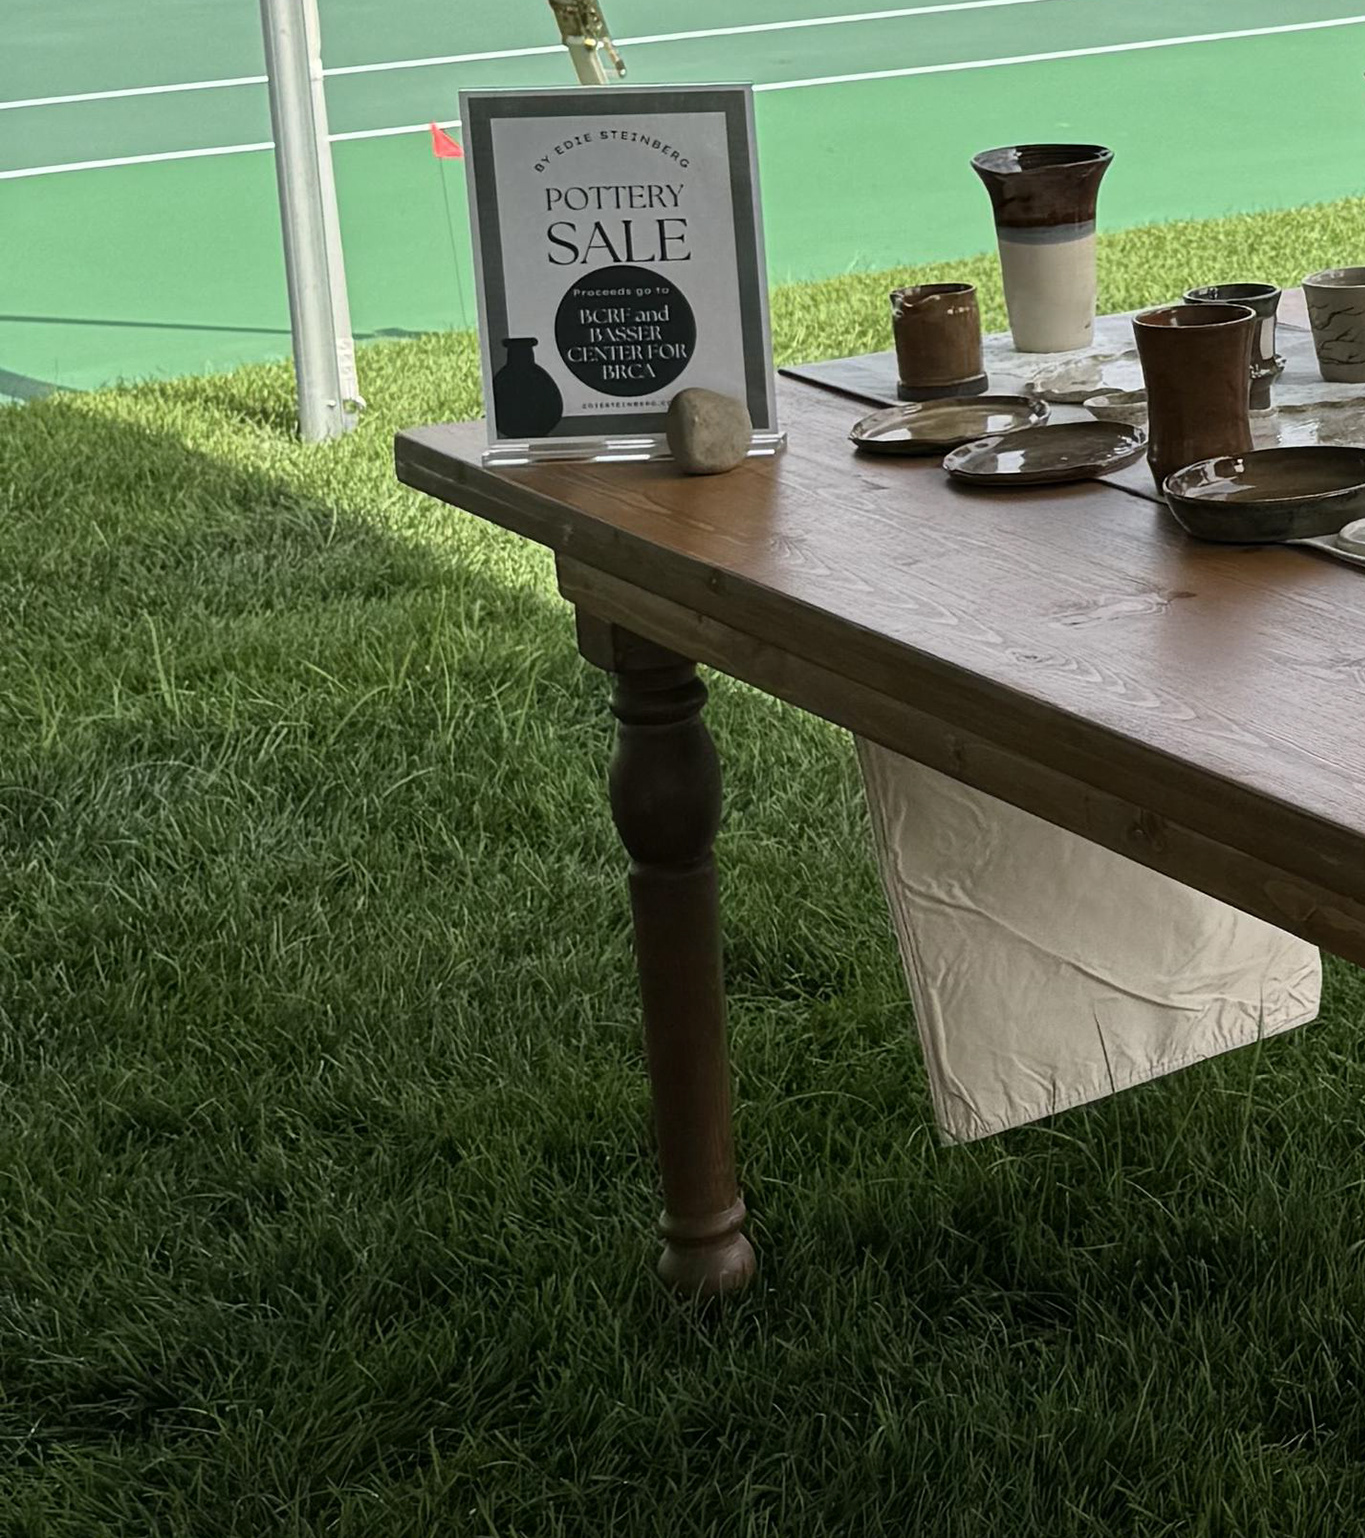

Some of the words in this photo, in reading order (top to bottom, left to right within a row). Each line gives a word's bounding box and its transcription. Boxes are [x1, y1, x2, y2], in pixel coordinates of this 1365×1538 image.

[534, 155, 551, 173] BY
[554, 133, 592, 155] EDIE
[600, 130, 690, 168] STEINBERG
[545, 184, 684, 211] POTTERY
[547, 218, 691, 265] SALE
[573, 287, 632, 297] Proceeds
[636, 287, 652, 297] go
[656, 287, 669, 295] to
[580, 307, 631, 324] BCRF
[635, 304, 669, 322] and
[590, 325, 662, 343] BASSER
[567, 344, 643, 362] CENTER
[648, 343, 687, 360] FOR
[603, 363, 656, 380] BRCA
